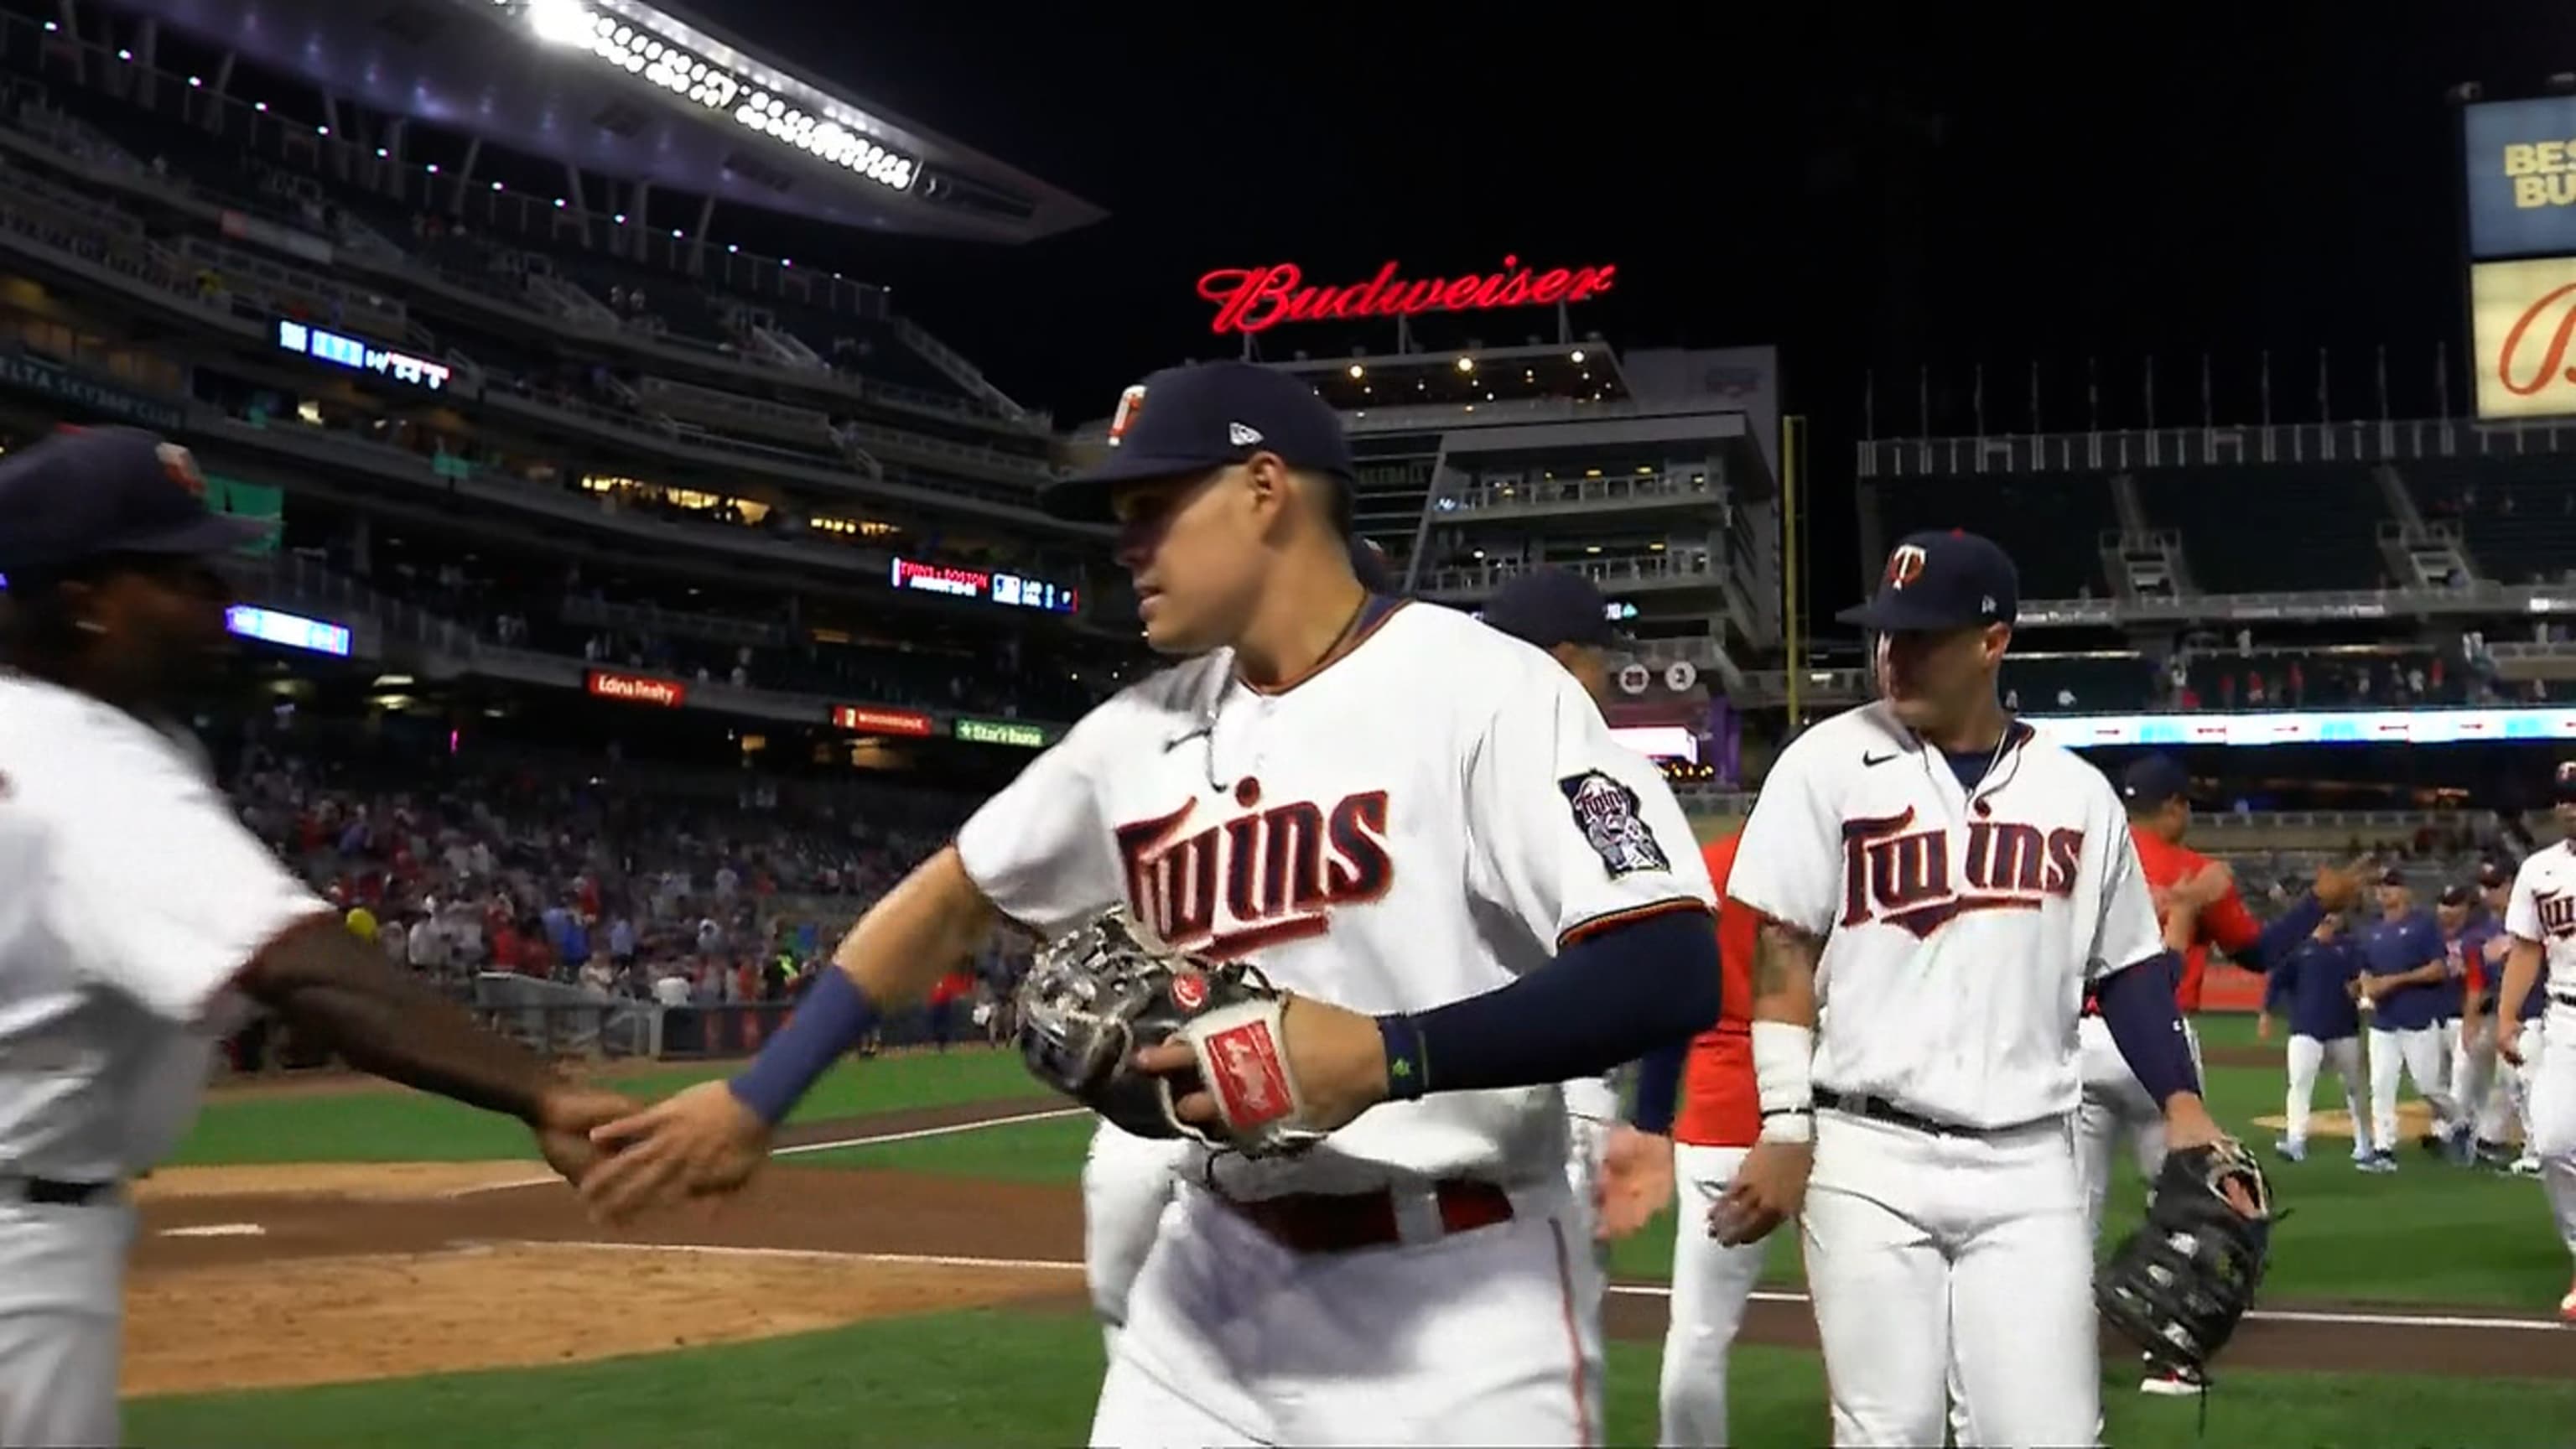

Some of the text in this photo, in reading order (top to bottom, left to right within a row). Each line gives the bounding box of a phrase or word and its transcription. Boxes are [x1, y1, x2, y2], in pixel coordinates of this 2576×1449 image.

[1197, 255, 1615, 333] Budweiser
[1114, 776, 1394, 954] Twins
[1841, 797, 2085, 934] Twins
